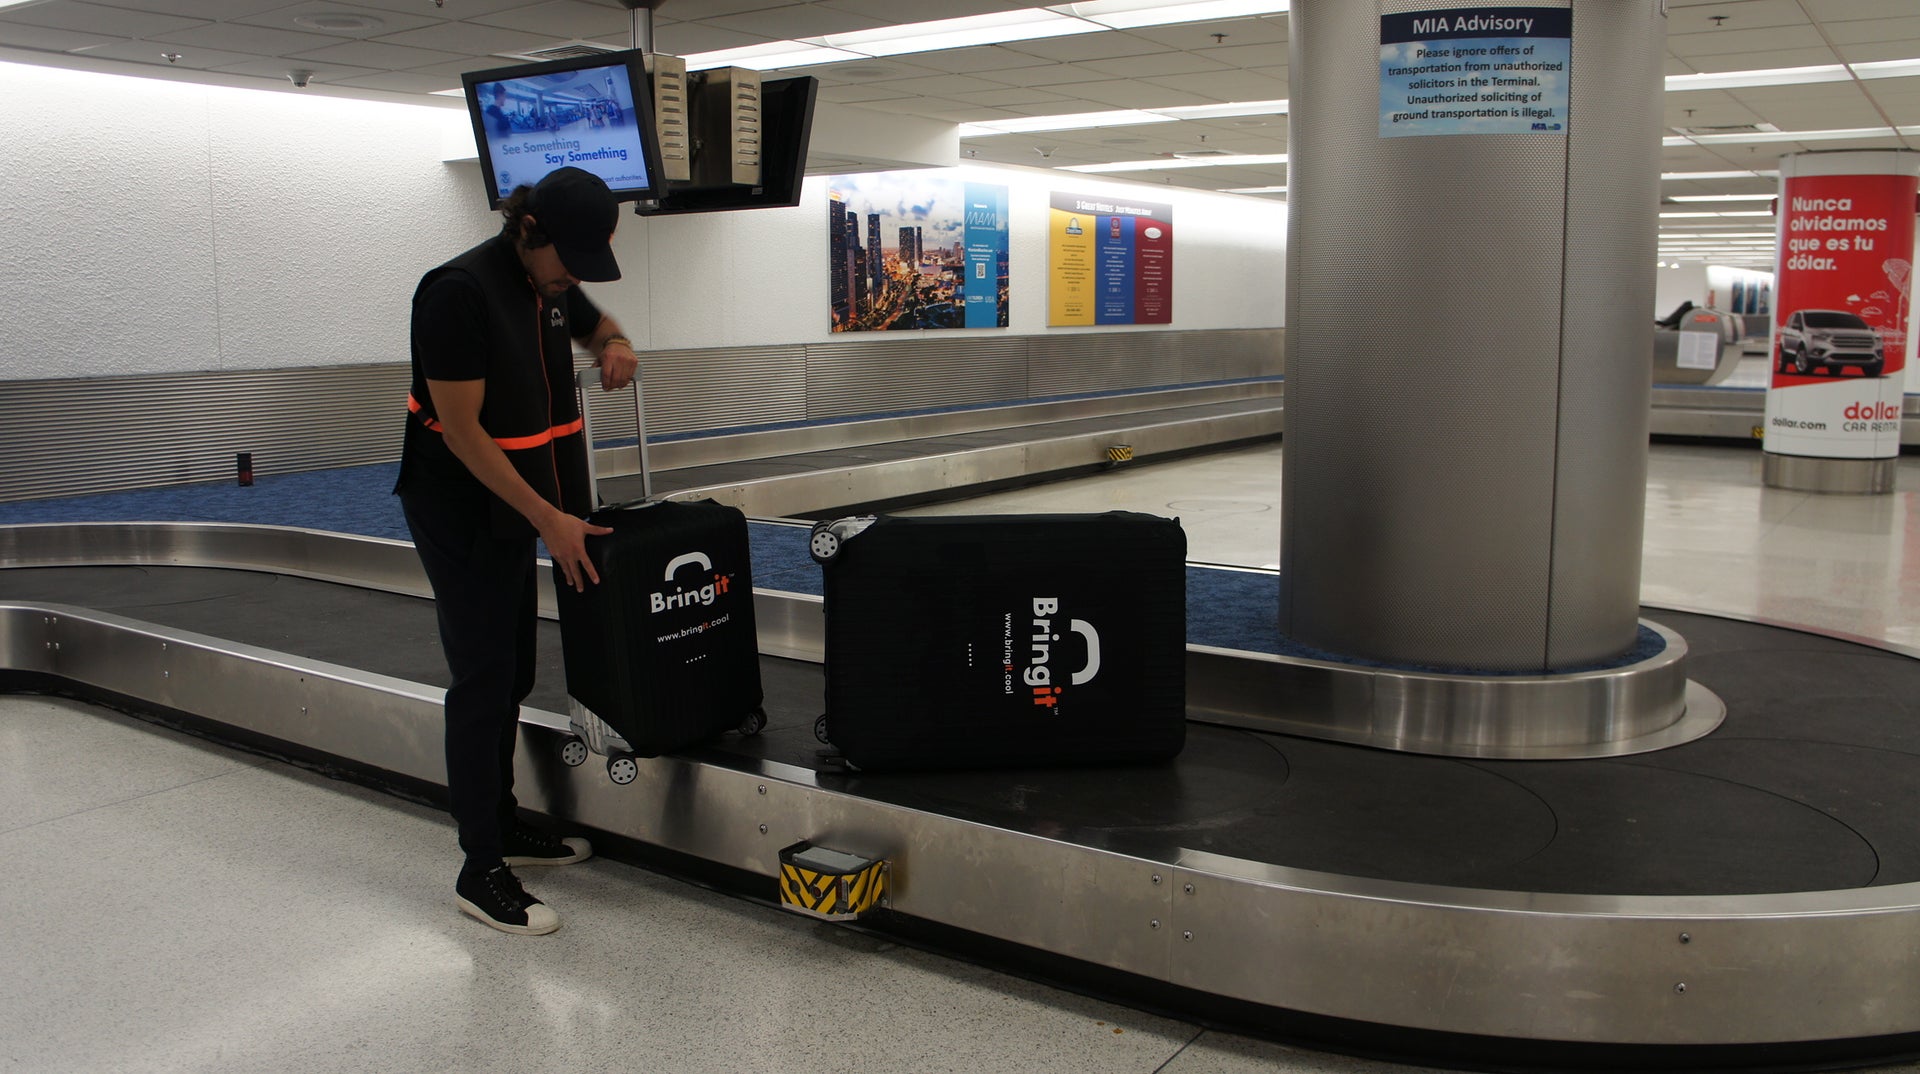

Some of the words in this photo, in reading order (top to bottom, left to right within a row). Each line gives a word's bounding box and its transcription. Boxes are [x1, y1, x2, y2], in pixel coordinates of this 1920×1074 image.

[1413, 18, 1449, 34] MIA
[1454, 15, 1533, 34] Advisory
[1416, 48, 1450, 58] Please
[1452, 48, 1487, 58] ignore
[1490, 46, 1520, 56] offers
[1522, 45, 1535, 55] of
[1388, 63, 1462, 76] transportation
[1464, 62, 1490, 72] from
[1493, 61, 1562, 72] unauthorized
[1408, 78, 1455, 90] solicitors
[1457, 78, 1468, 87] in
[1470, 77, 1488, 87] the
[1491, 76, 1540, 87] Terminal.
[1407, 94, 1478, 105] Unauthorized
[1480, 92, 1528, 104] soliciting
[1530, 92, 1542, 102] of
[1392, 110, 1428, 122] ground
[1431, 108, 1508, 121] transportation
[1510, 108, 1520, 118] is
[1522, 108, 1555, 120] illegal.
[502, 144, 521, 155] See
[523, 138, 581, 154] Something
[544, 152, 565, 166] Say
[568, 146, 628, 162] Something
[1792, 197, 1852, 212] Nunca
[1790, 215, 1887, 232] olvidamos
[1788, 238, 1820, 254] que
[1826, 238, 1850, 251] es
[1854, 236, 1874, 251] tu
[1787, 253, 1837, 271] dólar.
[1772, 416, 1826, 430] dollar.com
[1842, 421, 1867, 432] CAR
[650, 574, 730, 614] Bringit
[657, 614, 730, 643] www.bringit.cool
[1003, 612, 1014, 694] www.bringit.cool
[1024, 597, 1062, 708] Bringit
